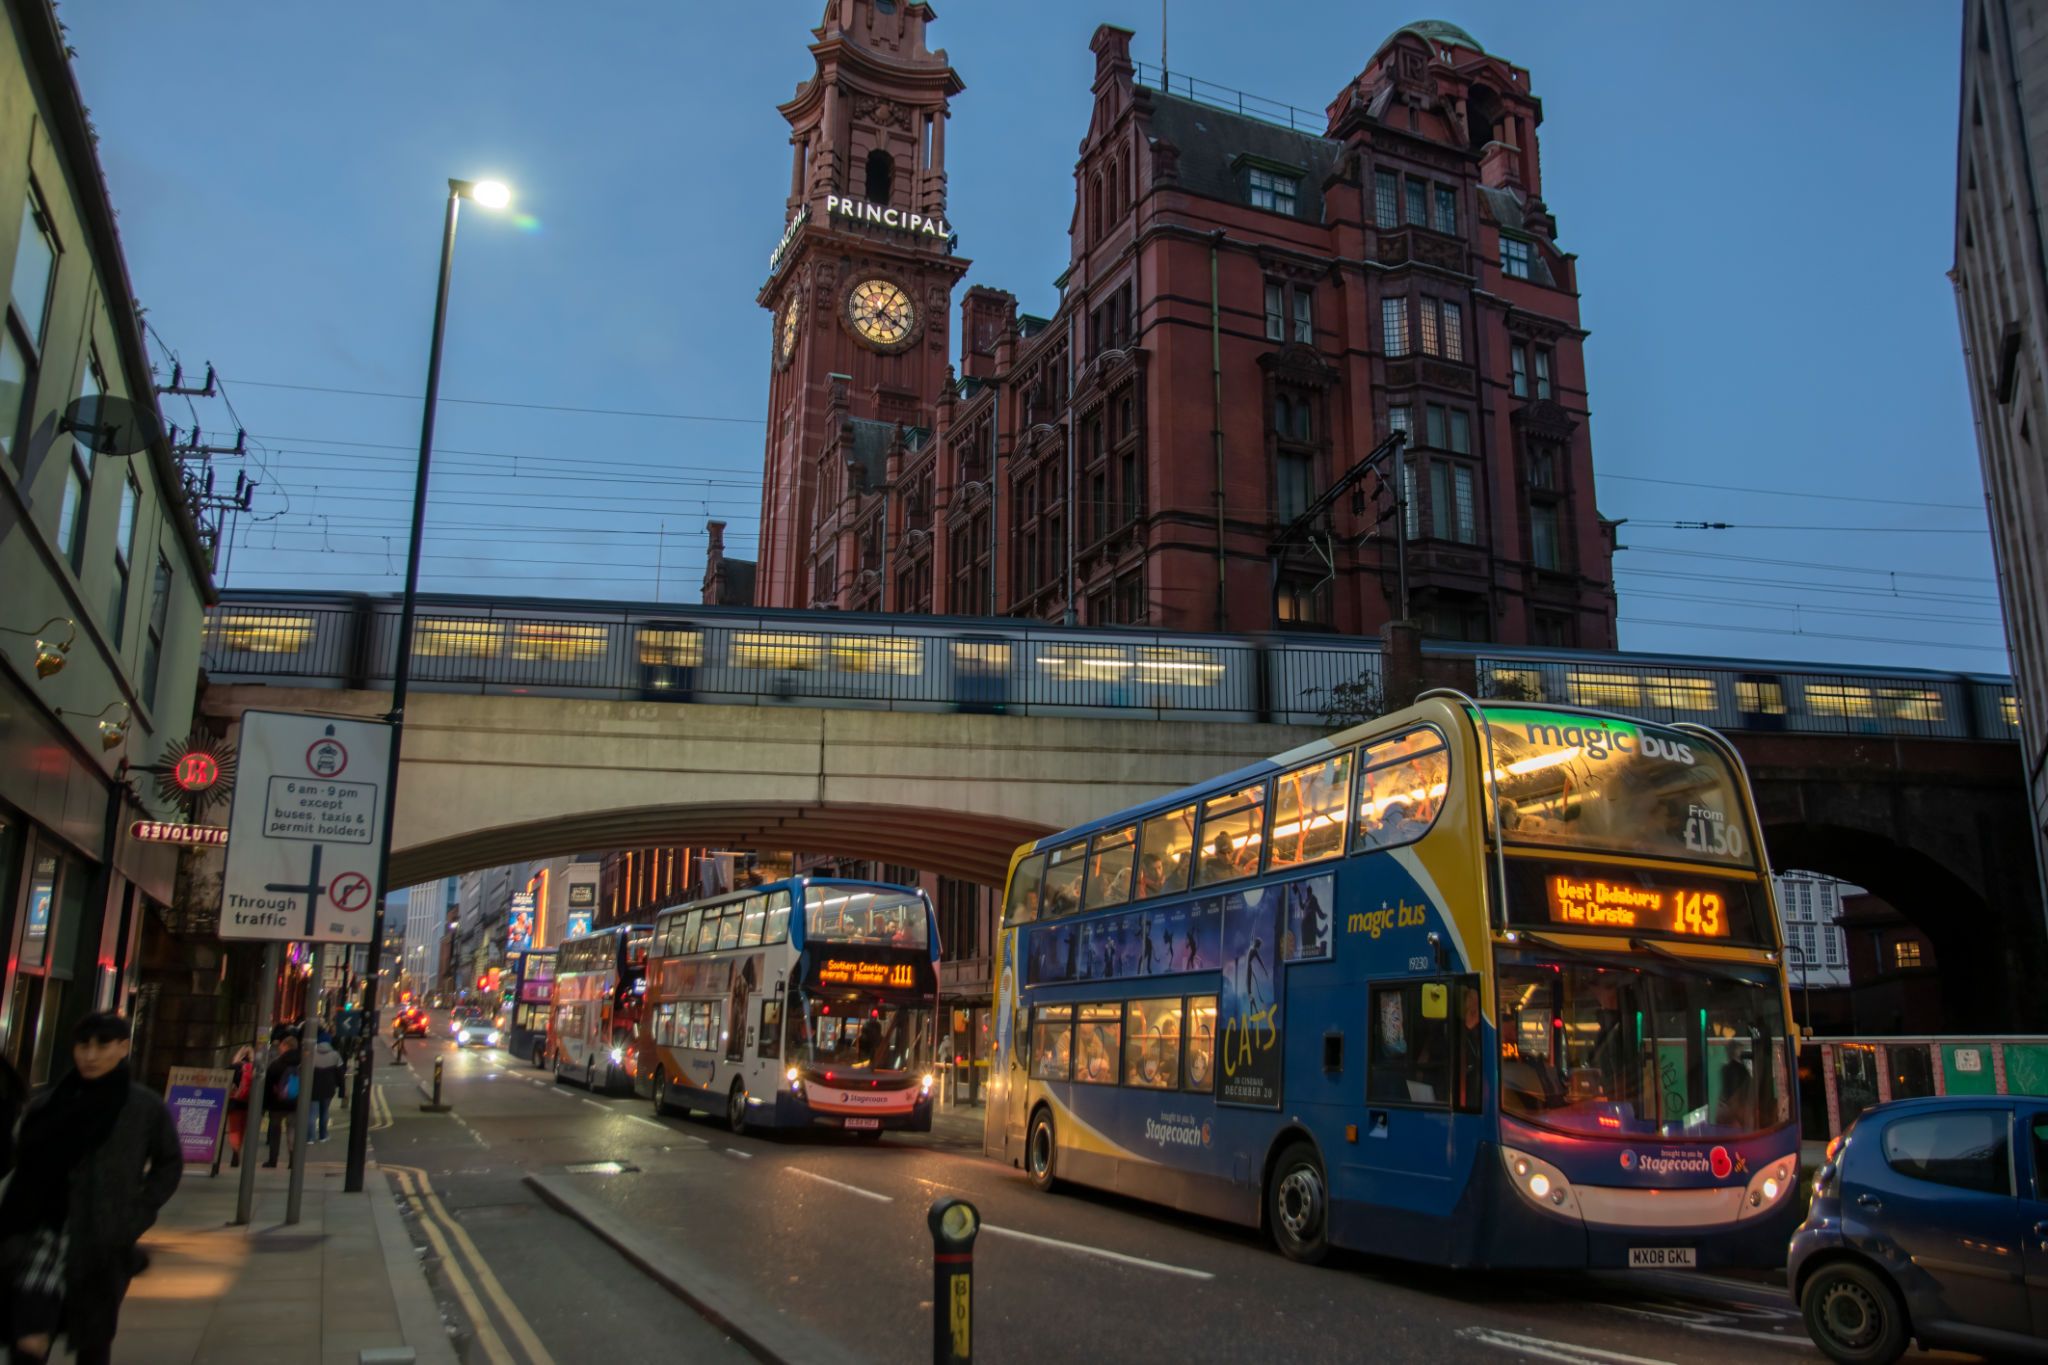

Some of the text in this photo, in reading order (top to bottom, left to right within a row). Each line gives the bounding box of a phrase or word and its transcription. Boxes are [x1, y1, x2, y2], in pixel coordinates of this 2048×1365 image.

[827, 195, 949, 238] PRINCIPAL
[770, 203, 807, 271] PRINCIPAL
[1525, 721, 1695, 765] magic bus
[287, 783, 295, 793] 6
[299, 785, 318, 794] am
[328, 786, 336, 796] 9
[338, 788, 358, 798] pm
[300, 798, 343, 810] except
[1688, 804, 1724, 822] From
[322, 811, 352, 822] taxis
[356, 814, 364, 823] &
[140, 824, 229, 843] REVOLUTIO
[271, 822, 366, 836] permit holders
[1683, 818, 1742, 858] £1.50
[229, 894, 296, 912] Through
[1556, 878, 1662, 911] West Didsbury
[235, 914, 288, 926] traffic
[1347, 899, 1426, 938] magic bus
[1560, 899, 1635, 924] The Christie
[1674, 891, 1720, 935] 143
[828, 960, 889, 974] Southern Cemetery
[895, 965, 912, 985] 111
[1224, 1004, 1278, 1077] CATS
[1225, 1085, 1272, 1098] DECEMBER 20
[1145, 1118, 1201, 1146] Stagecoach
[1639, 1155, 1709, 1174] Stagecoach
[1634, 1250, 1690, 1264] MX08 GKL
